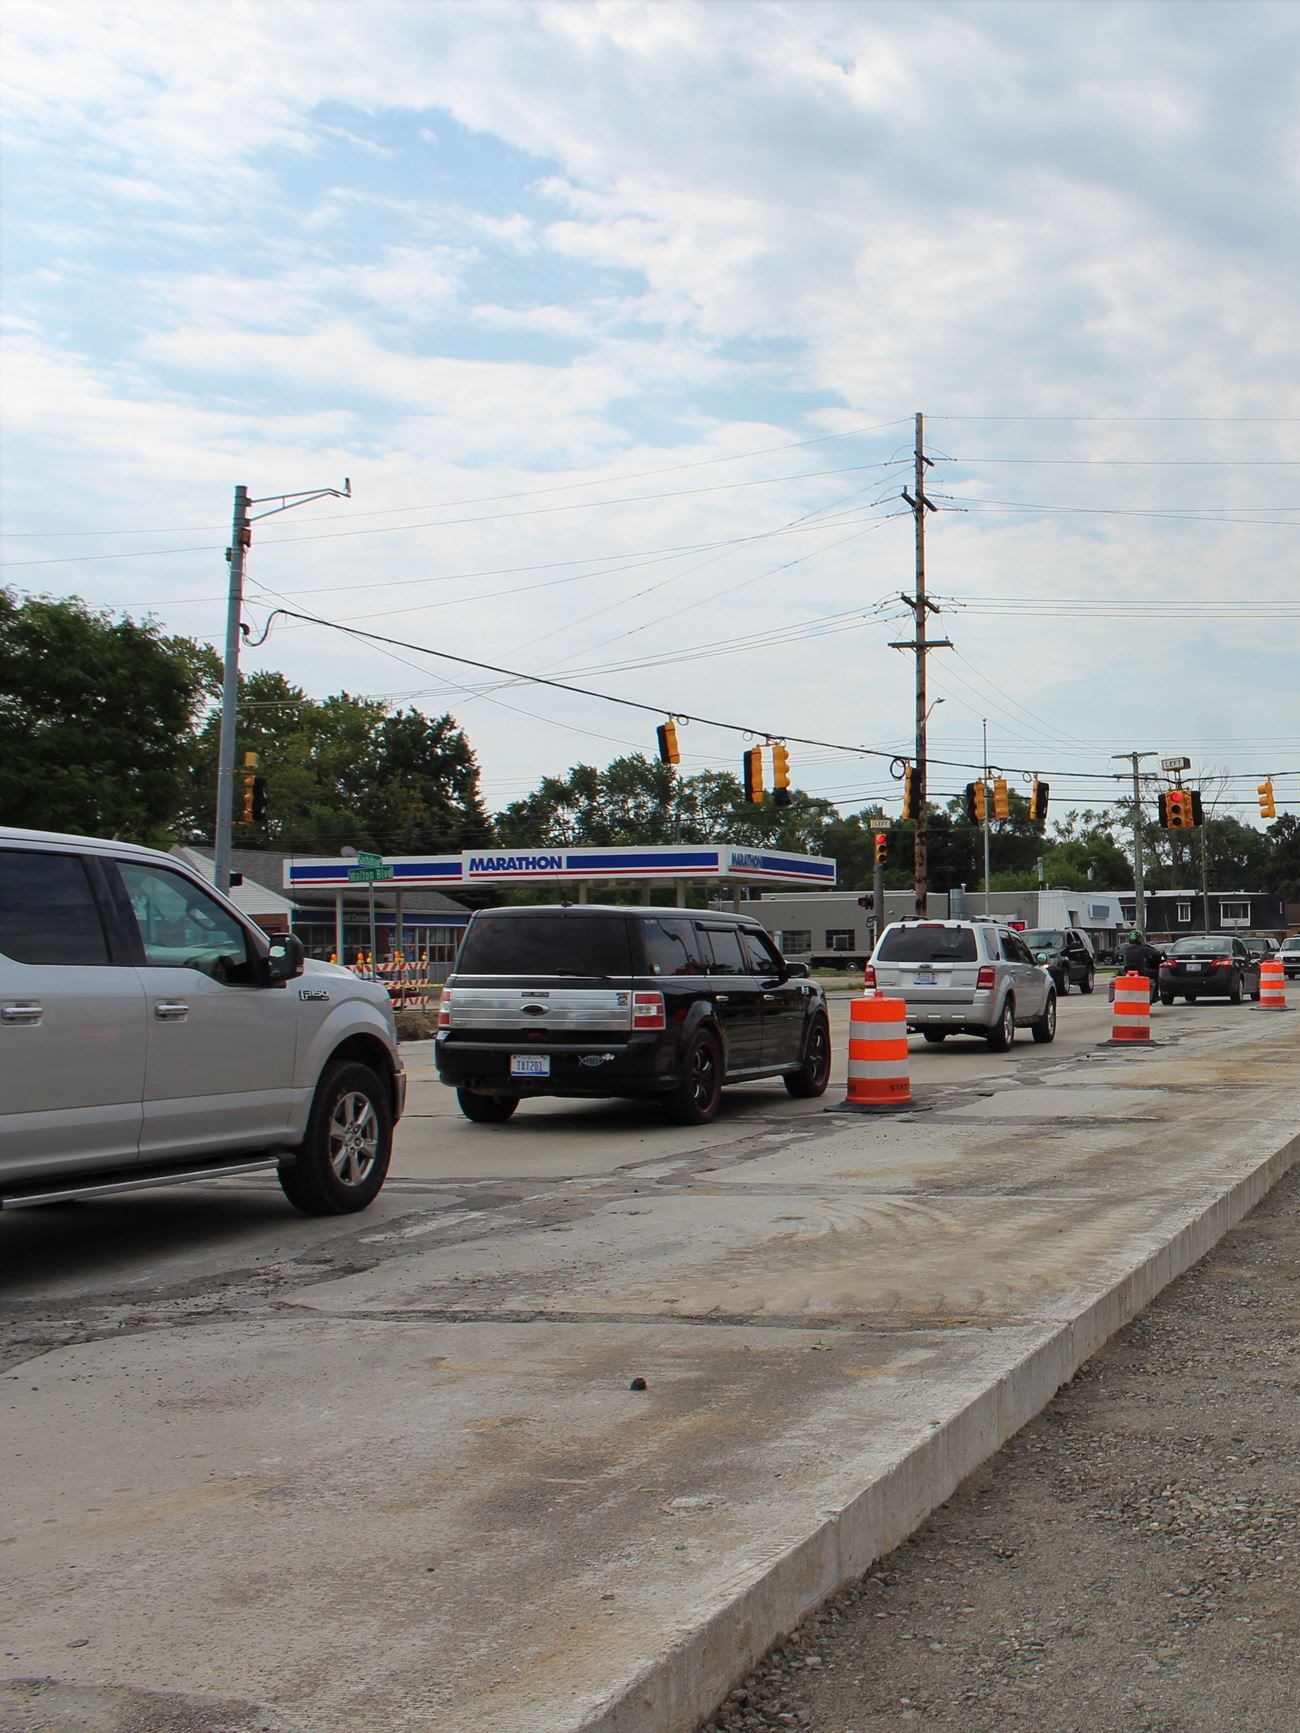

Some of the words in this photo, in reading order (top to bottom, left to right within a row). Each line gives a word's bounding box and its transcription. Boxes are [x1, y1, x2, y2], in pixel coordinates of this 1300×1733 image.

[1165, 759, 1183, 767] LEFT
[469, 856, 562, 871] MARATHON
[731, 852, 761, 867] MARATHON
[349, 869, 374, 881] Walton
[376, 867, 393, 880] Blvd
